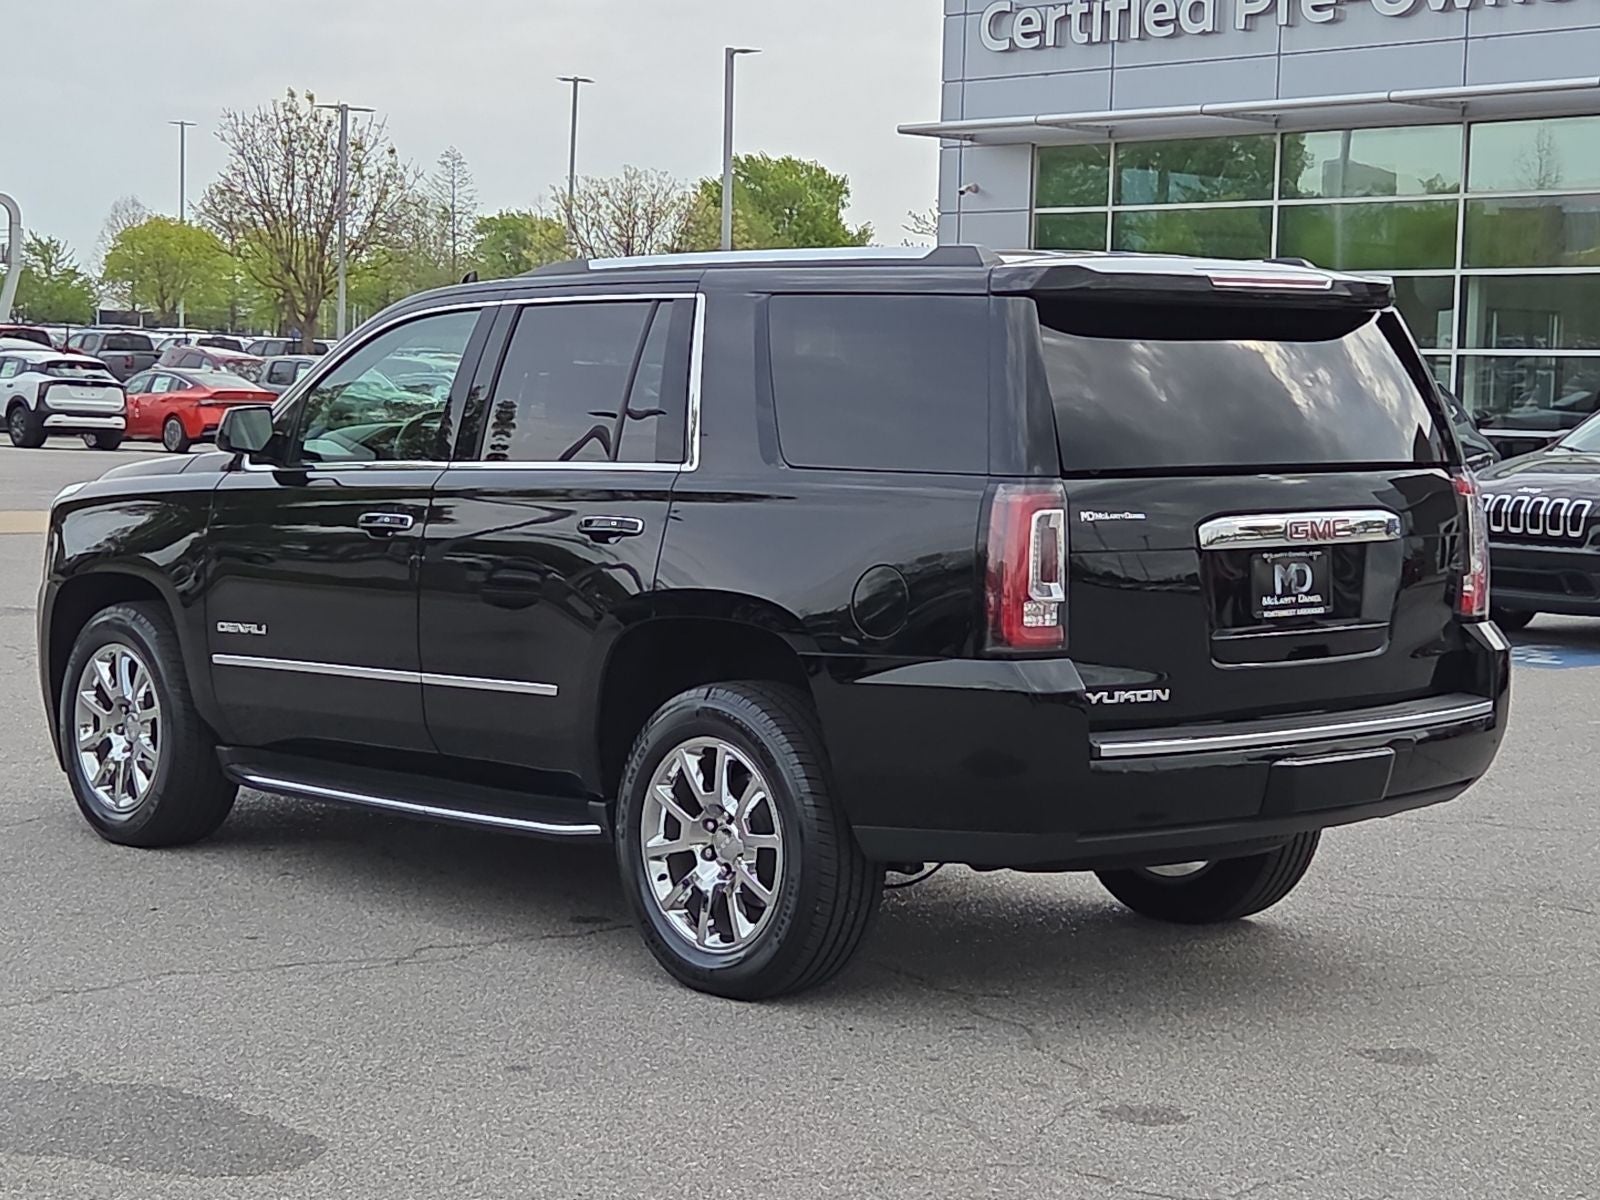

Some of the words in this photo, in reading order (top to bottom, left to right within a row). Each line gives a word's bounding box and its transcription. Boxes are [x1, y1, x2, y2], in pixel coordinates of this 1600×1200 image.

[979, 0, 1215, 52] Certified
[1289, 518, 1350, 540] GMC
[1274, 562, 1313, 595] MD
[1085, 688, 1170, 705] YUKON
